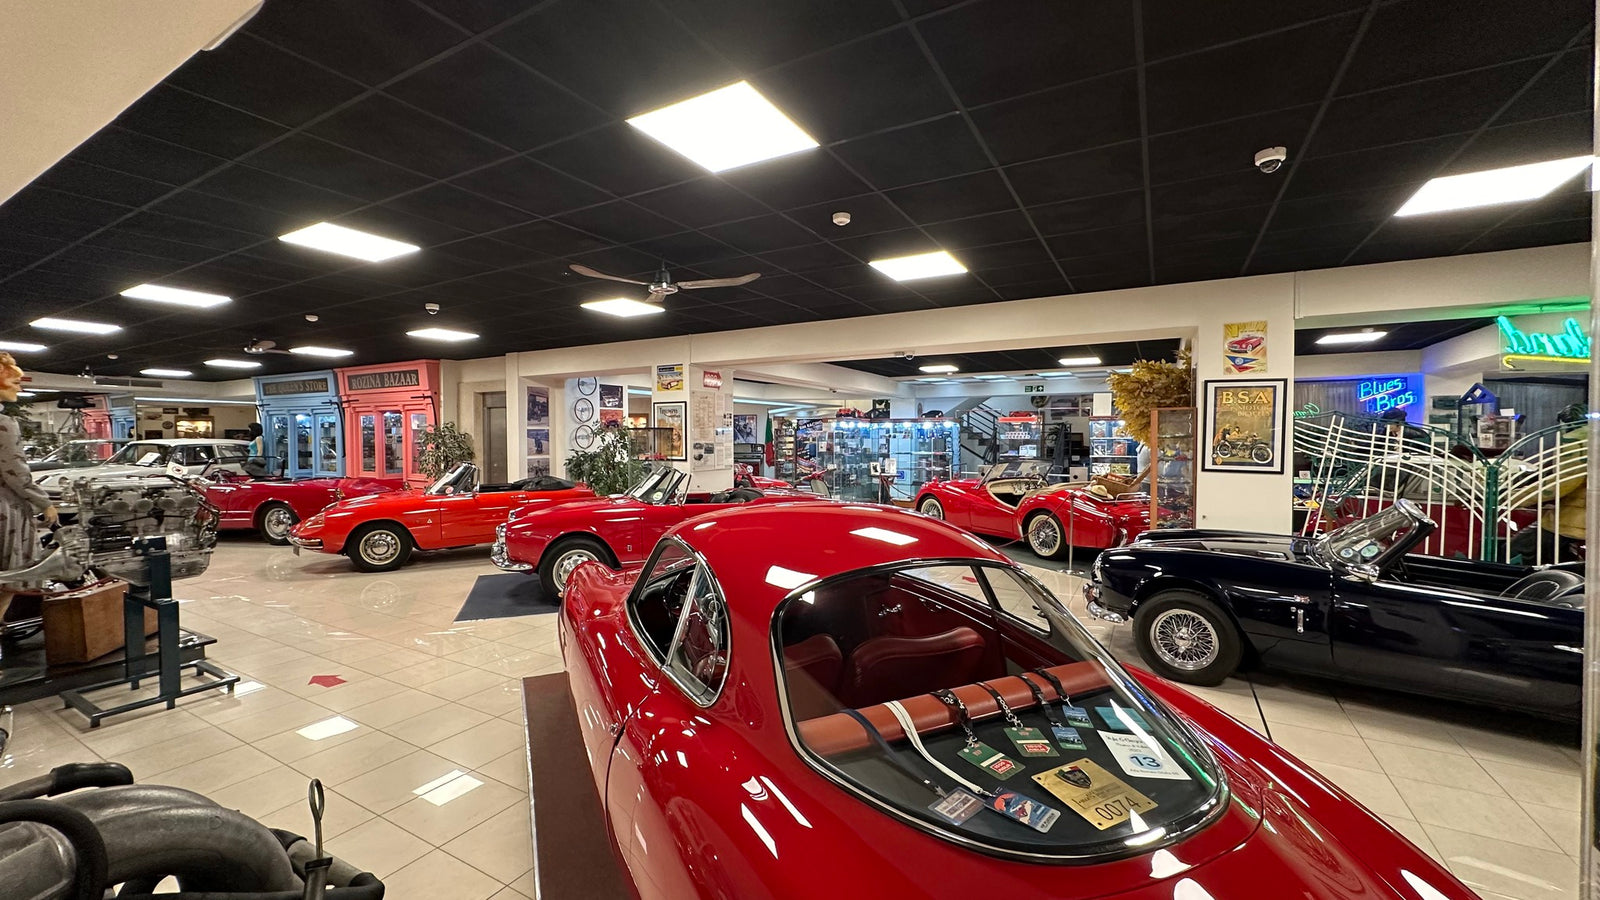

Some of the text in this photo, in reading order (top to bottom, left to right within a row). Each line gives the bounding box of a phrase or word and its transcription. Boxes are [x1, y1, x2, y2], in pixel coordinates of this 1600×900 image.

[265, 381, 328, 394] THE QUEEN'S STORE
[351, 373, 418, 389] ROZINA BAZAAR
[1359, 378, 1403, 399] Blues
[1374, 391, 1414, 413] Bros
[1130, 755, 1160, 767] 13
[1095, 796, 1141, 820] 0074
